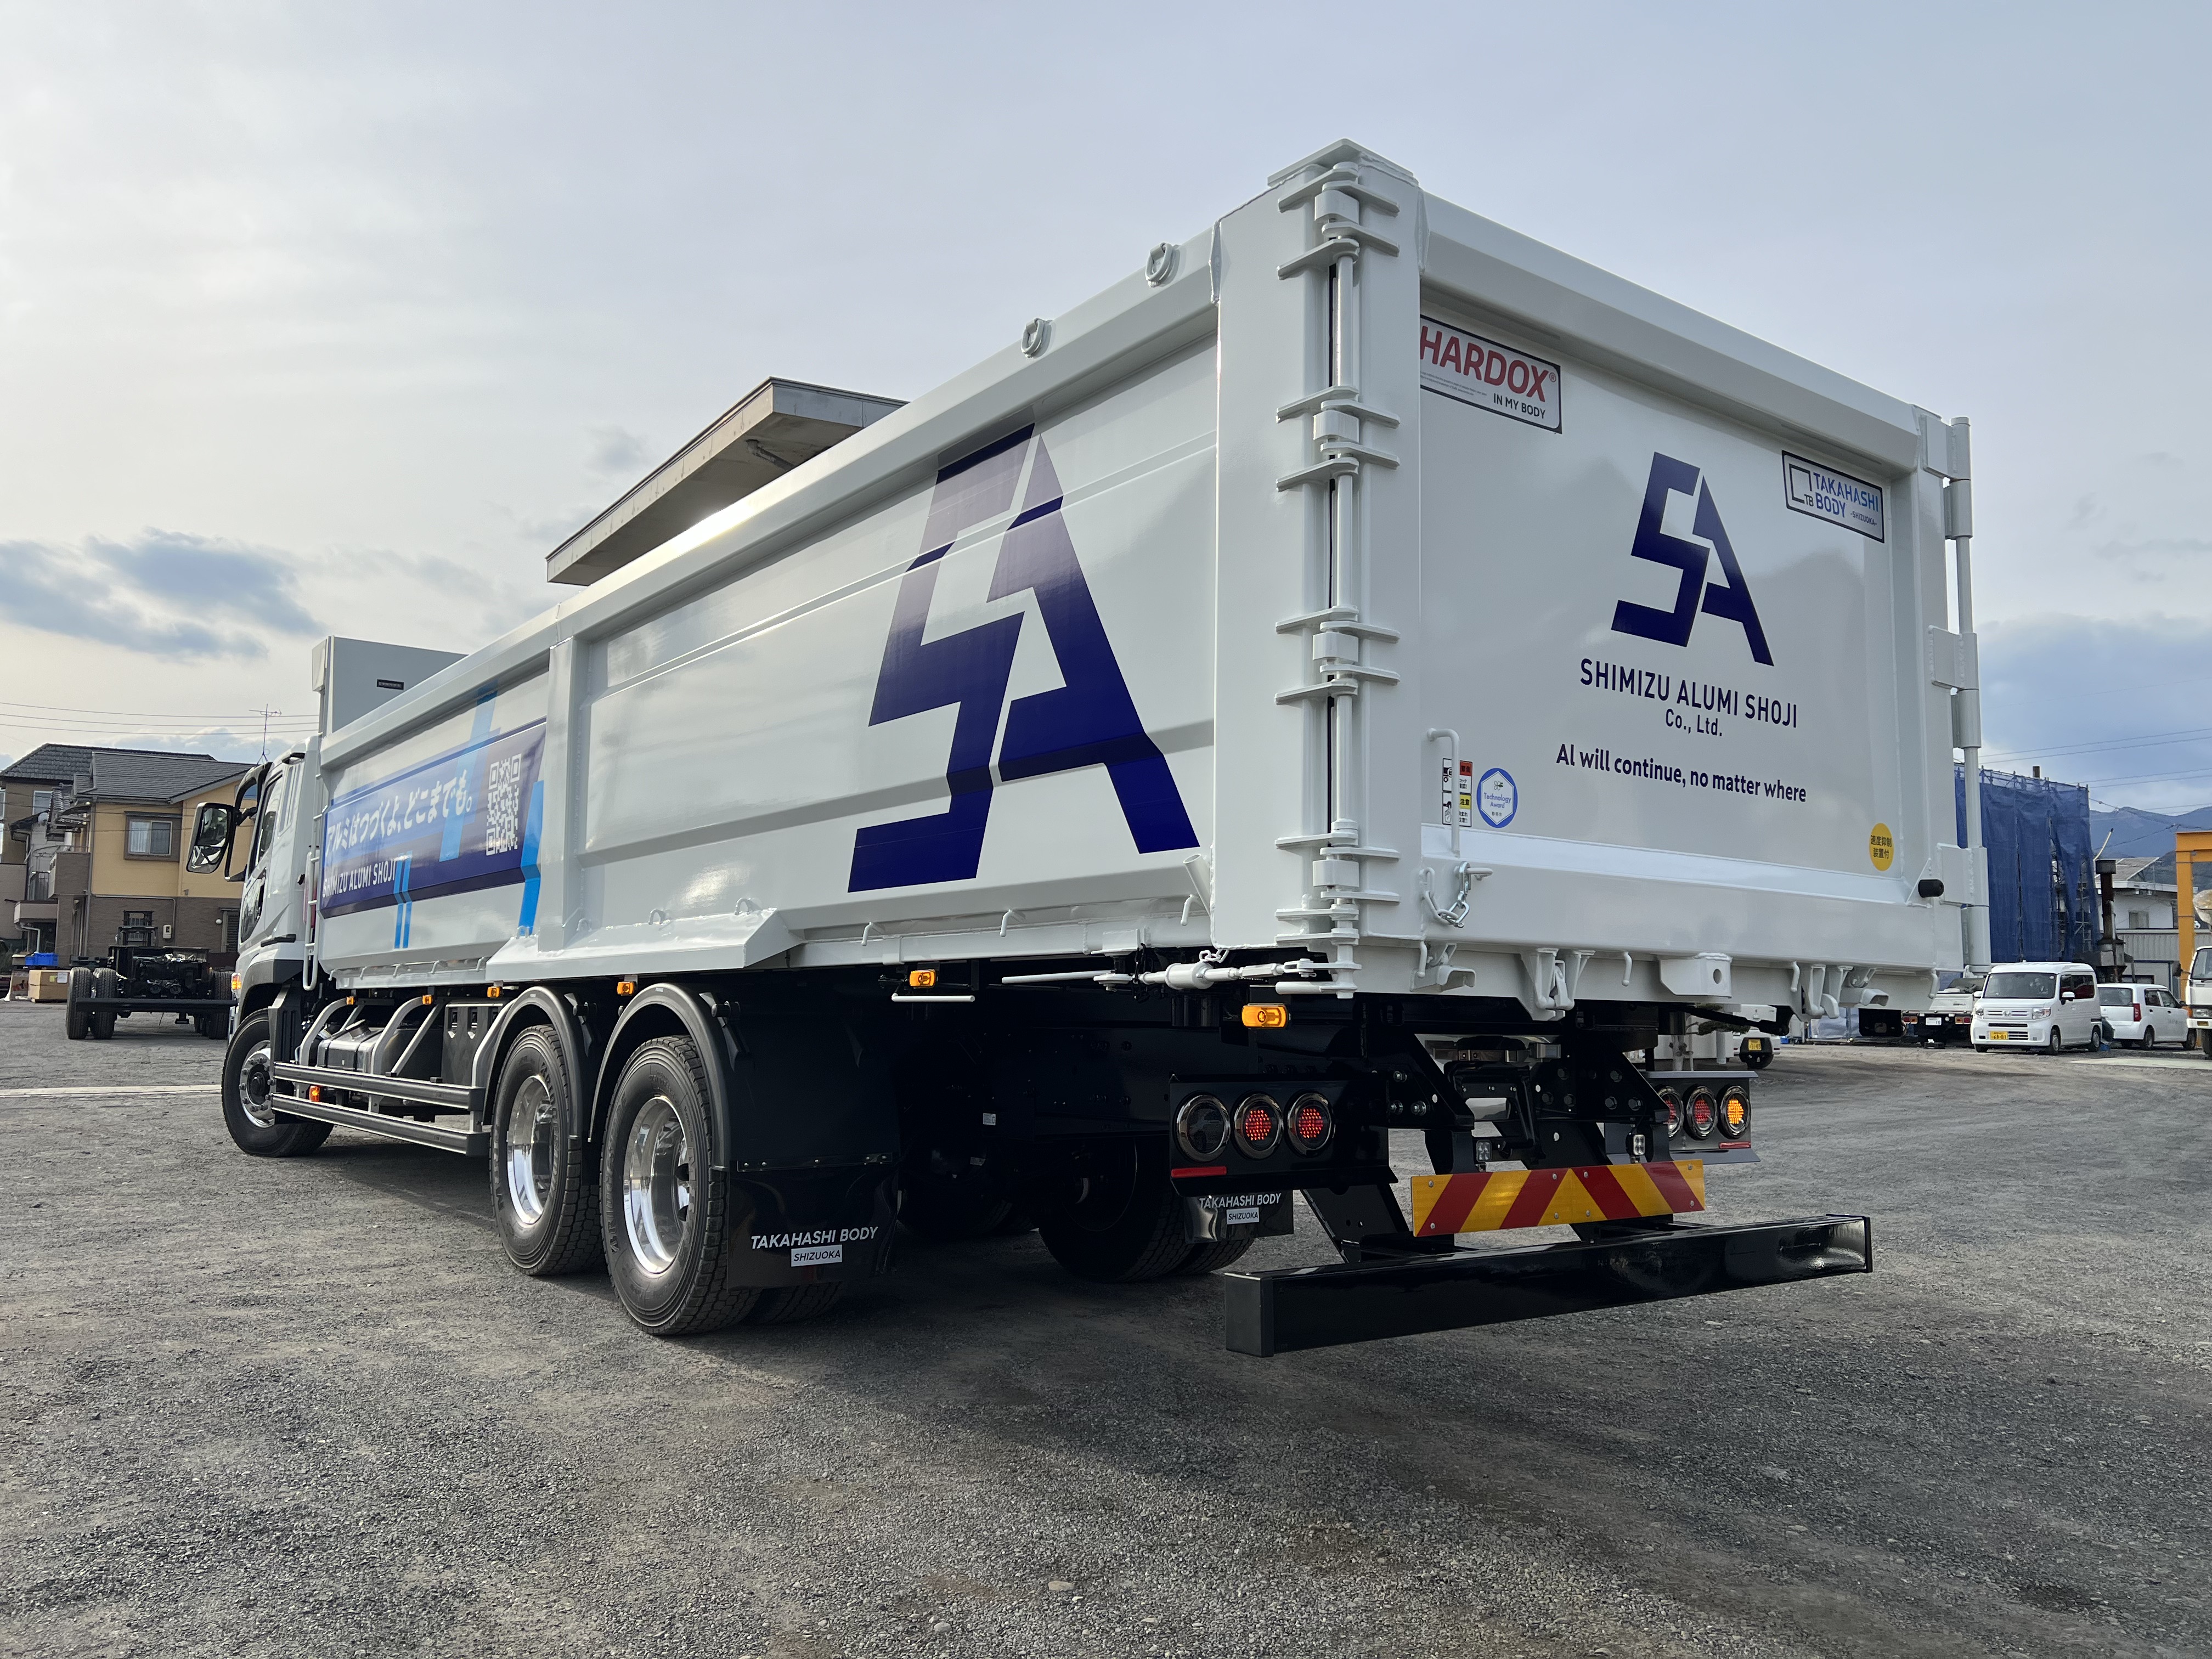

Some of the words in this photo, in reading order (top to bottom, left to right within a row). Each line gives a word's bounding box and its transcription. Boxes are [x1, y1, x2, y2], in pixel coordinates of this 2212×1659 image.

[1493, 393, 1503, 405] IN
[1505, 397, 1519, 410] MY
[1521, 403, 1545, 419] BODY
[1813, 472, 1878, 512] TAKAHASHI
[1815, 492, 1846, 518] BODY
[1580, 658, 1671, 701] SHIMIZU
[1676, 679, 1738, 716] ALUMI
[1745, 694, 1797, 728] SHOJI
[1665, 708, 1691, 734] Co.,
[1697, 715, 1723, 737] Ltd.
[1579, 748, 1610, 772] will
[1614, 757, 1686, 788] continue,
[1690, 770, 1709, 787] no
[1712, 772, 1761, 796] matter
[1764, 779, 1807, 803] where
[1483, 792, 1511, 804] Technology
[1870, 834, 1892, 848] 速度抑制
[1873, 847, 1889, 860] 装置付
[322, 871, 349, 898] SHIMIZU
[349, 865, 371, 891] ALUMI
[373, 859, 396, 885] SHOJI
[1199, 1194, 1255, 1209] TAKAHASHI
[1257, 1193, 1282, 1205] BODY
[1228, 1211, 1258, 1221] SHIZUOKA
[751, 1229, 836, 1249] TAKAHASHI
[839, 1226, 878, 1242] BODY
[793, 1250, 841, 1262] SHIZUOKA
